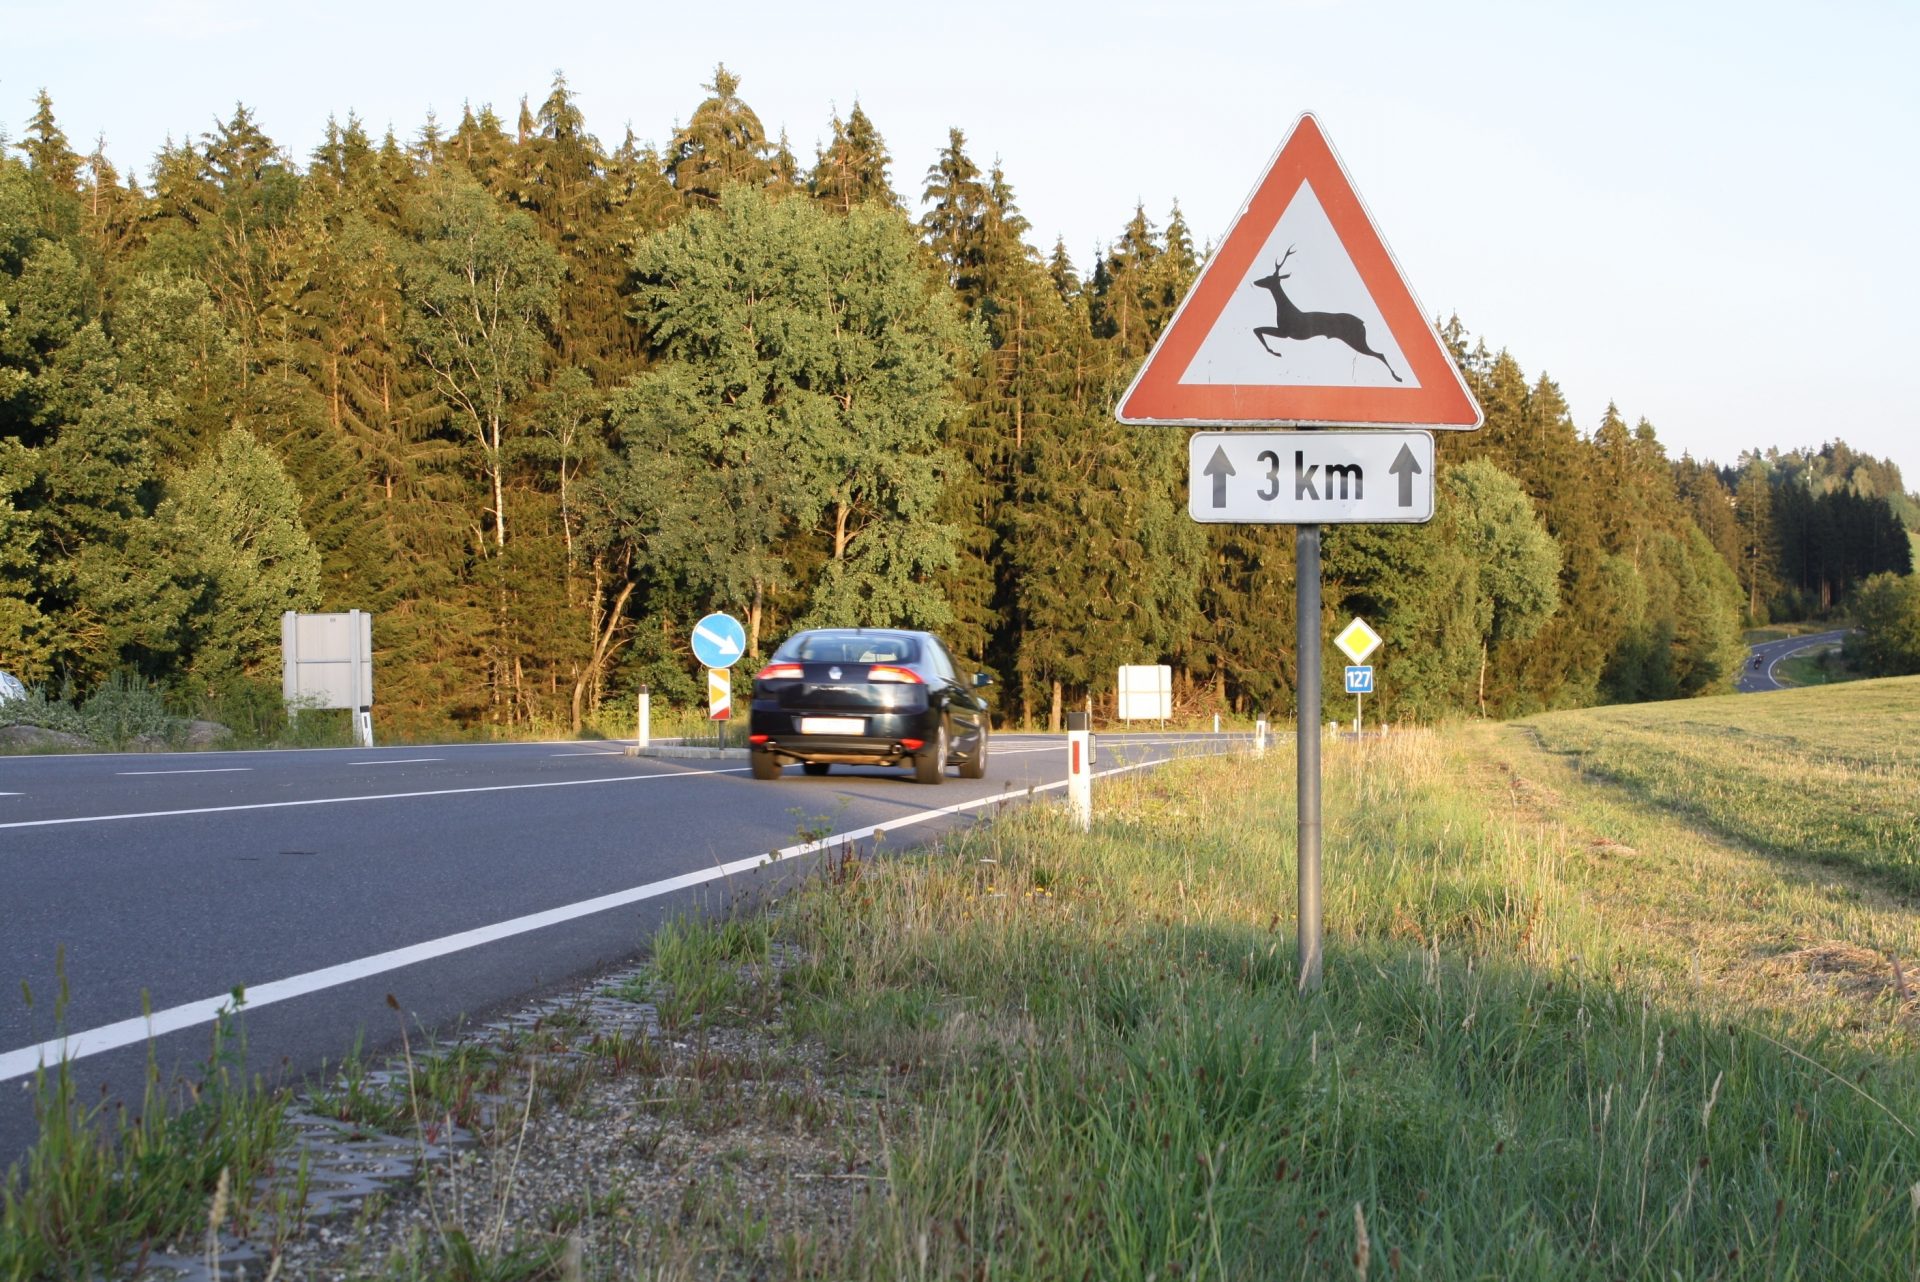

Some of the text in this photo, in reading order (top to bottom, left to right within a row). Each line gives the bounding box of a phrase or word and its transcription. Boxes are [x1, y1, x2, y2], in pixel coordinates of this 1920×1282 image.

[1256, 450, 1364, 501] 3 km
[1347, 671, 1371, 688] 127
